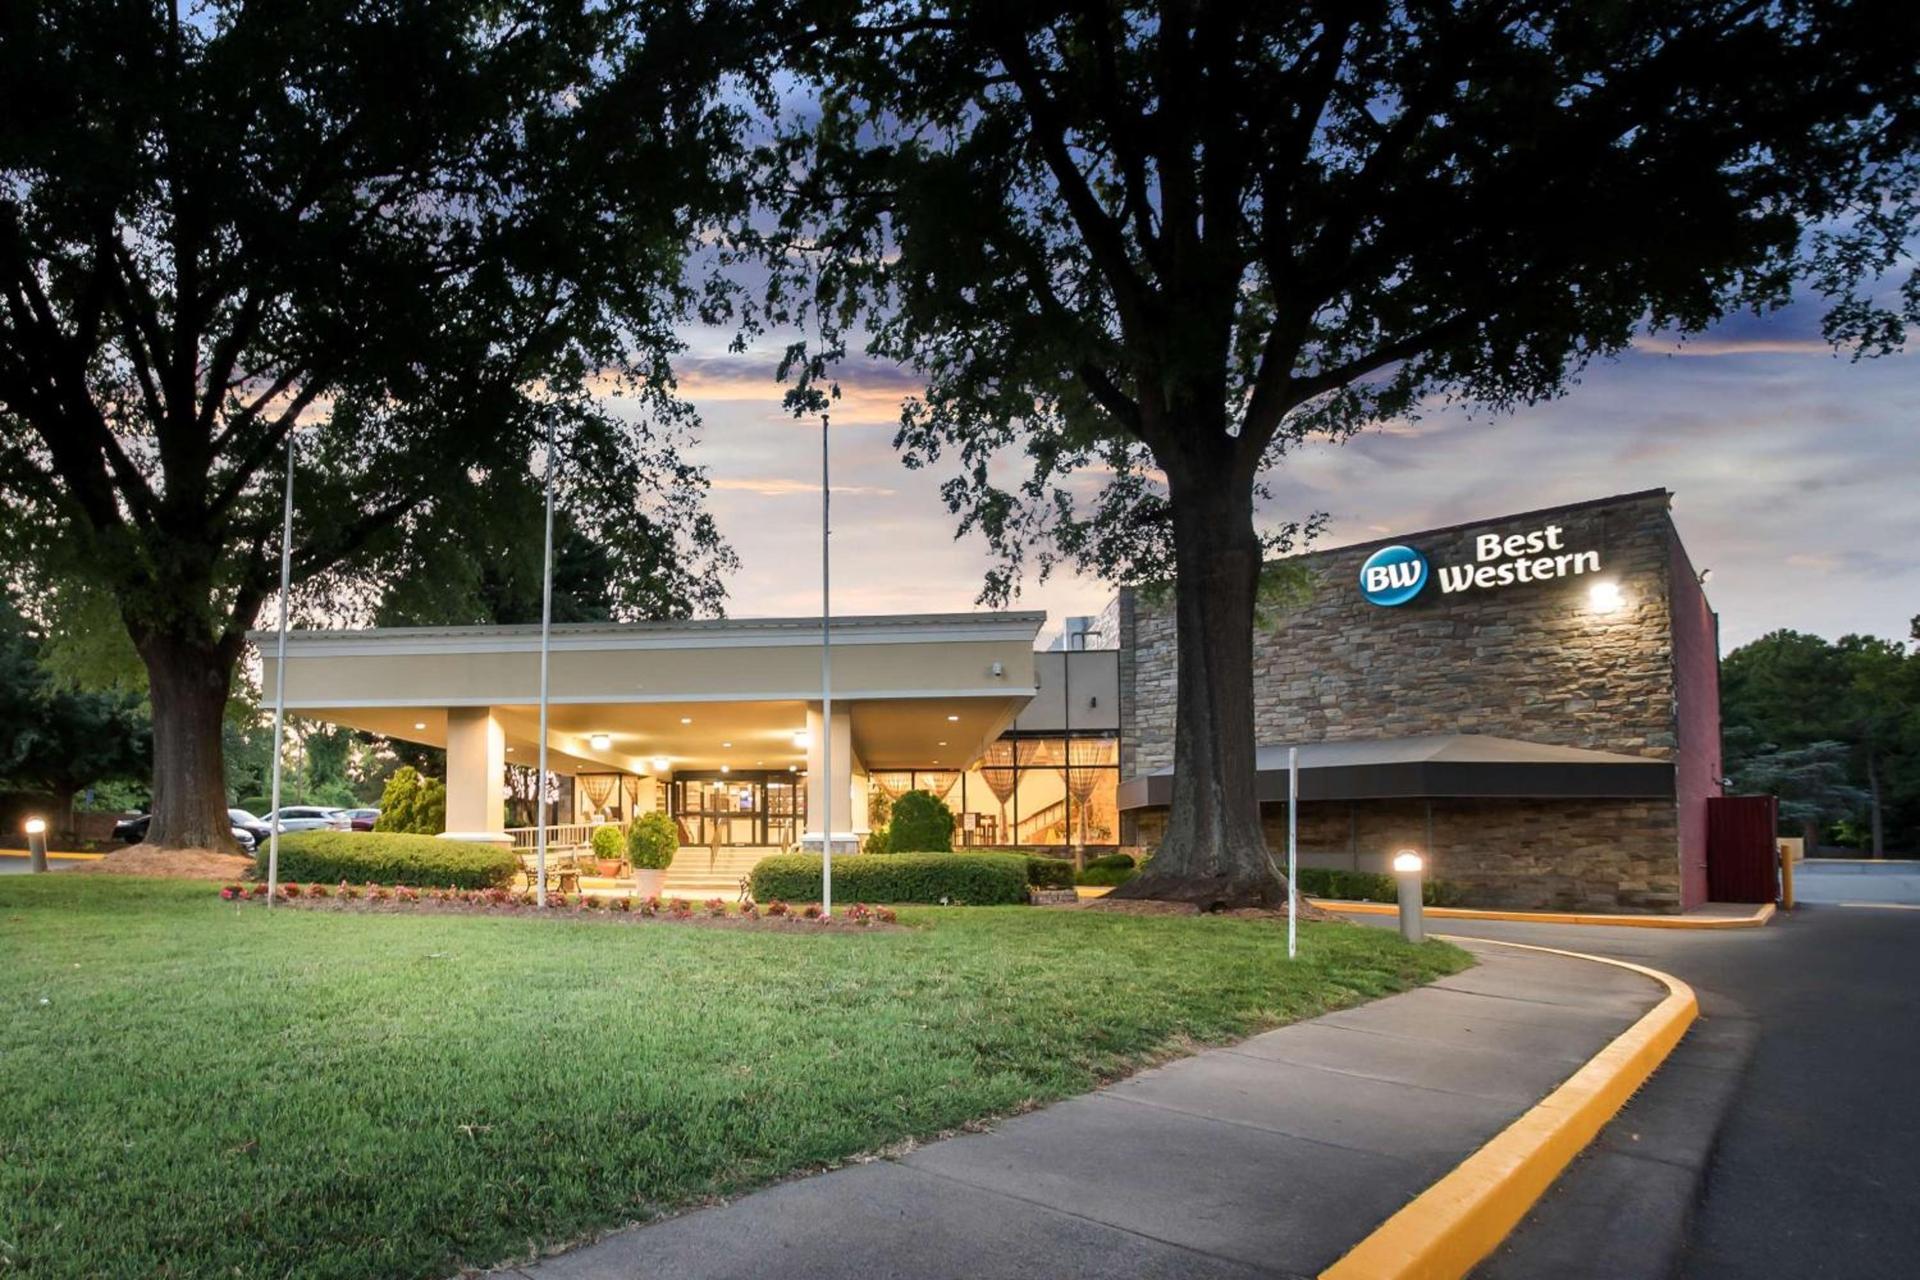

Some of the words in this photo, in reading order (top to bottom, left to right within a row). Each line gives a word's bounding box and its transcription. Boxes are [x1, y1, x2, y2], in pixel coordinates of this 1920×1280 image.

[1476, 525, 1564, 562] Best
[1366, 560, 1421, 592] BW
[1438, 550, 1601, 594] Western
